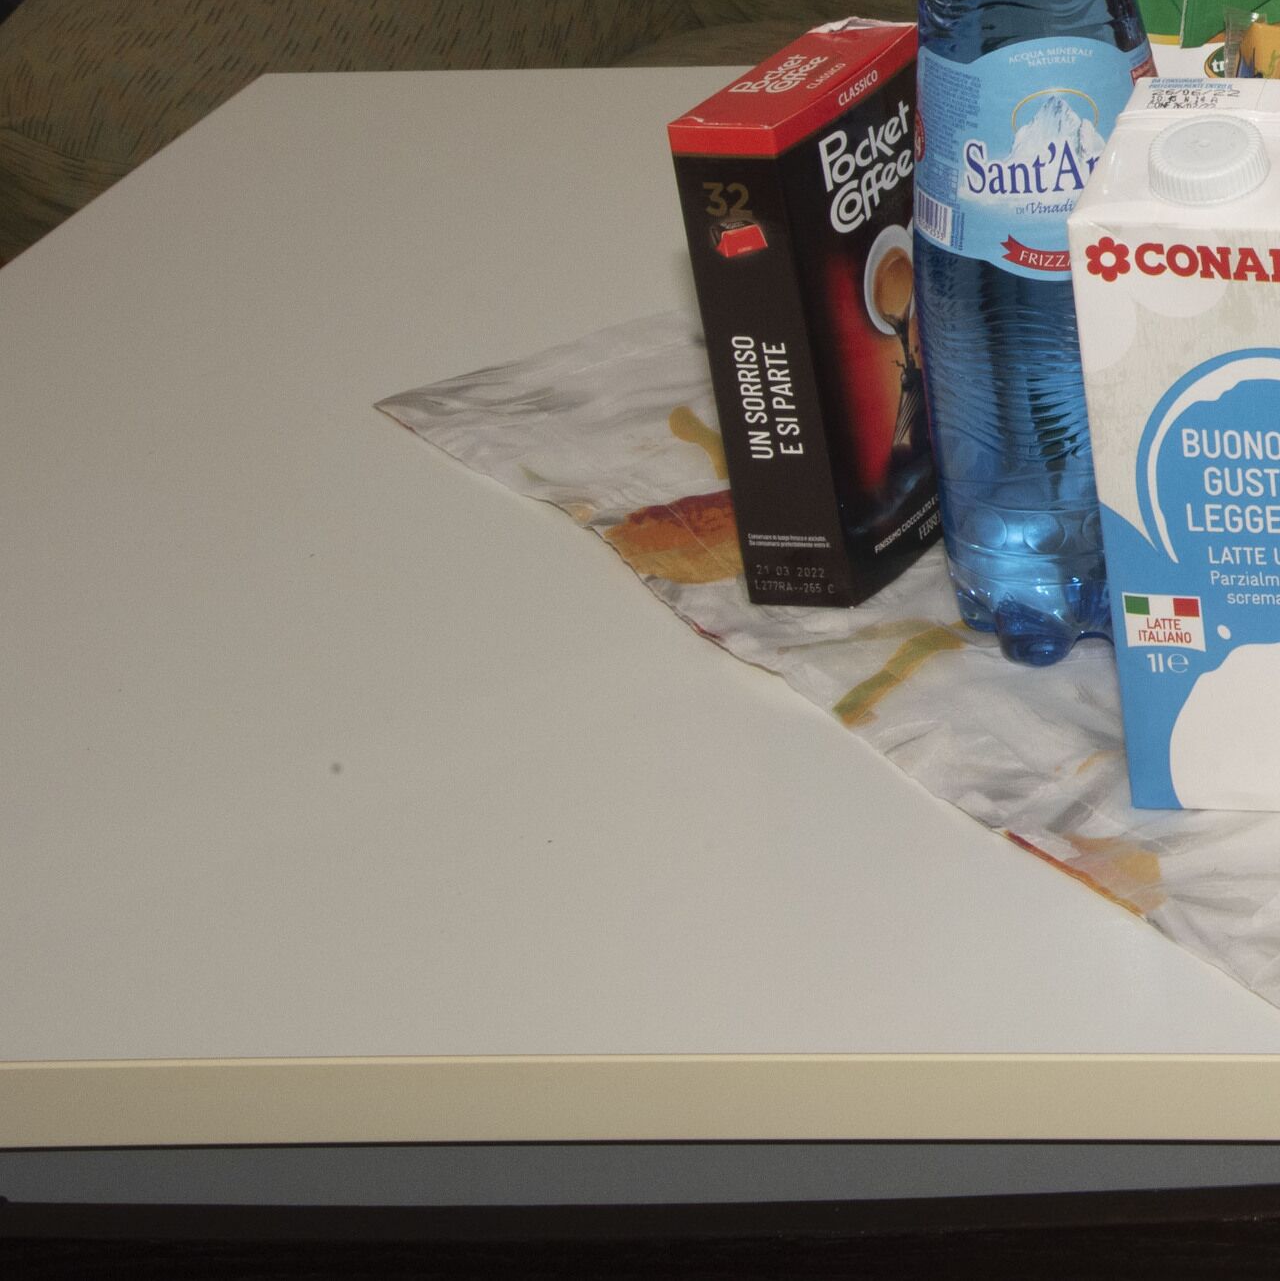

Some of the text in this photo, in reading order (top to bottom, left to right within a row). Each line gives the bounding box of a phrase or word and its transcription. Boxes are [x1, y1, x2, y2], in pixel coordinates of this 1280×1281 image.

[1008, 46, 1095, 65] ACQUA MINERALE
[1026, 55, 1078, 68] NATURALE
[727, 53, 808, 94] Pocket
[837, 69, 879, 107] CLASSICO
[817, 99, 911, 193] Pocket
[702, 181, 753, 217] 32
[829, 148, 915, 234] Coffee
[1019, 250, 1072, 269] FRIZZ
[731, 335, 775, 460] UN SORRISO
[761, 341, 804, 456] E SI PARTE
[873, 525, 903, 555] FINISSIMO
[1207, 545, 1266, 567] LATTE
[796, 566, 825, 579] 2022
[1137, 629, 1192, 644] ITALIANO
[1145, 617, 1182, 631] LATTE
